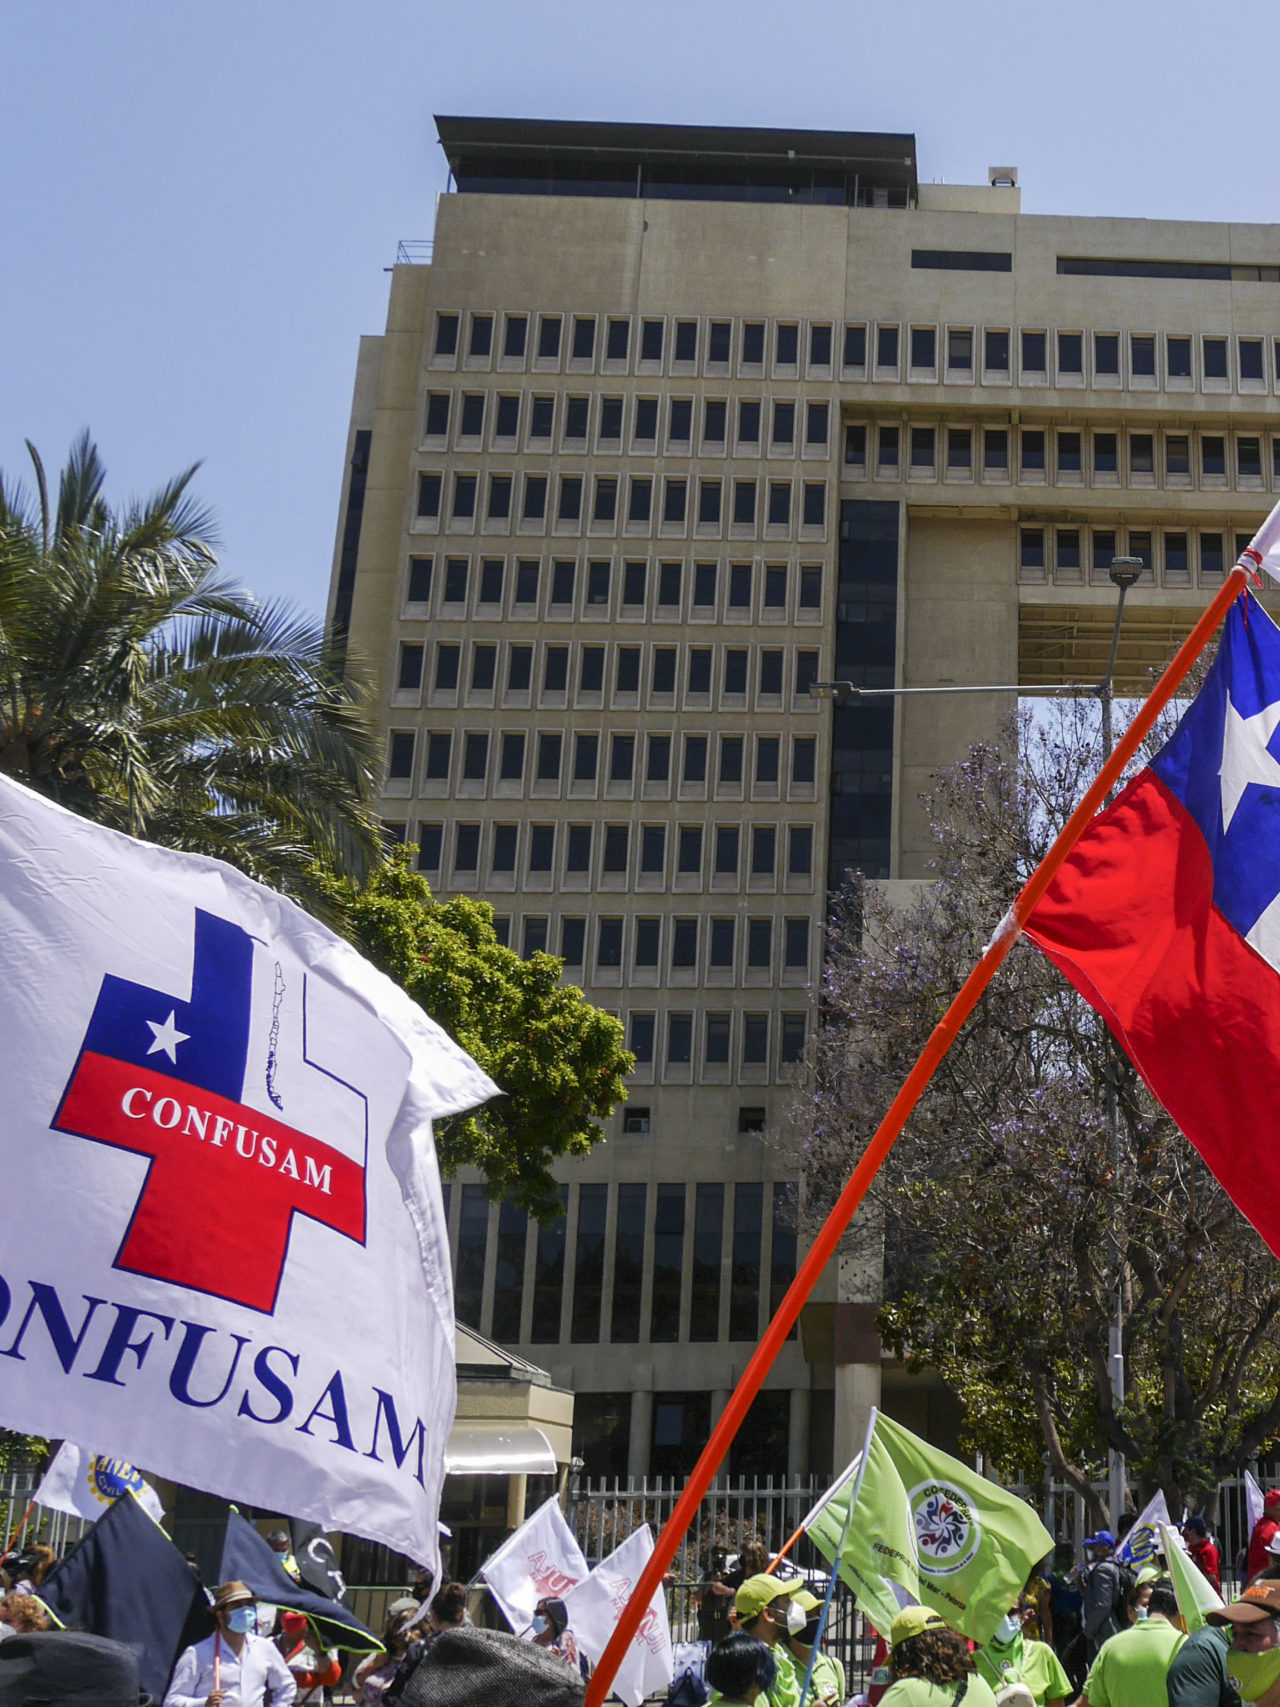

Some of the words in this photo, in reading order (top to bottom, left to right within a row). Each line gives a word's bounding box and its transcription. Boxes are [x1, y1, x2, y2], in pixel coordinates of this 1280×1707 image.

[121, 1087, 333, 1195] CONFUSAM
[0, 1274, 426, 1489] NFUSAM
[98, 1475, 122, 1496] CHIL
